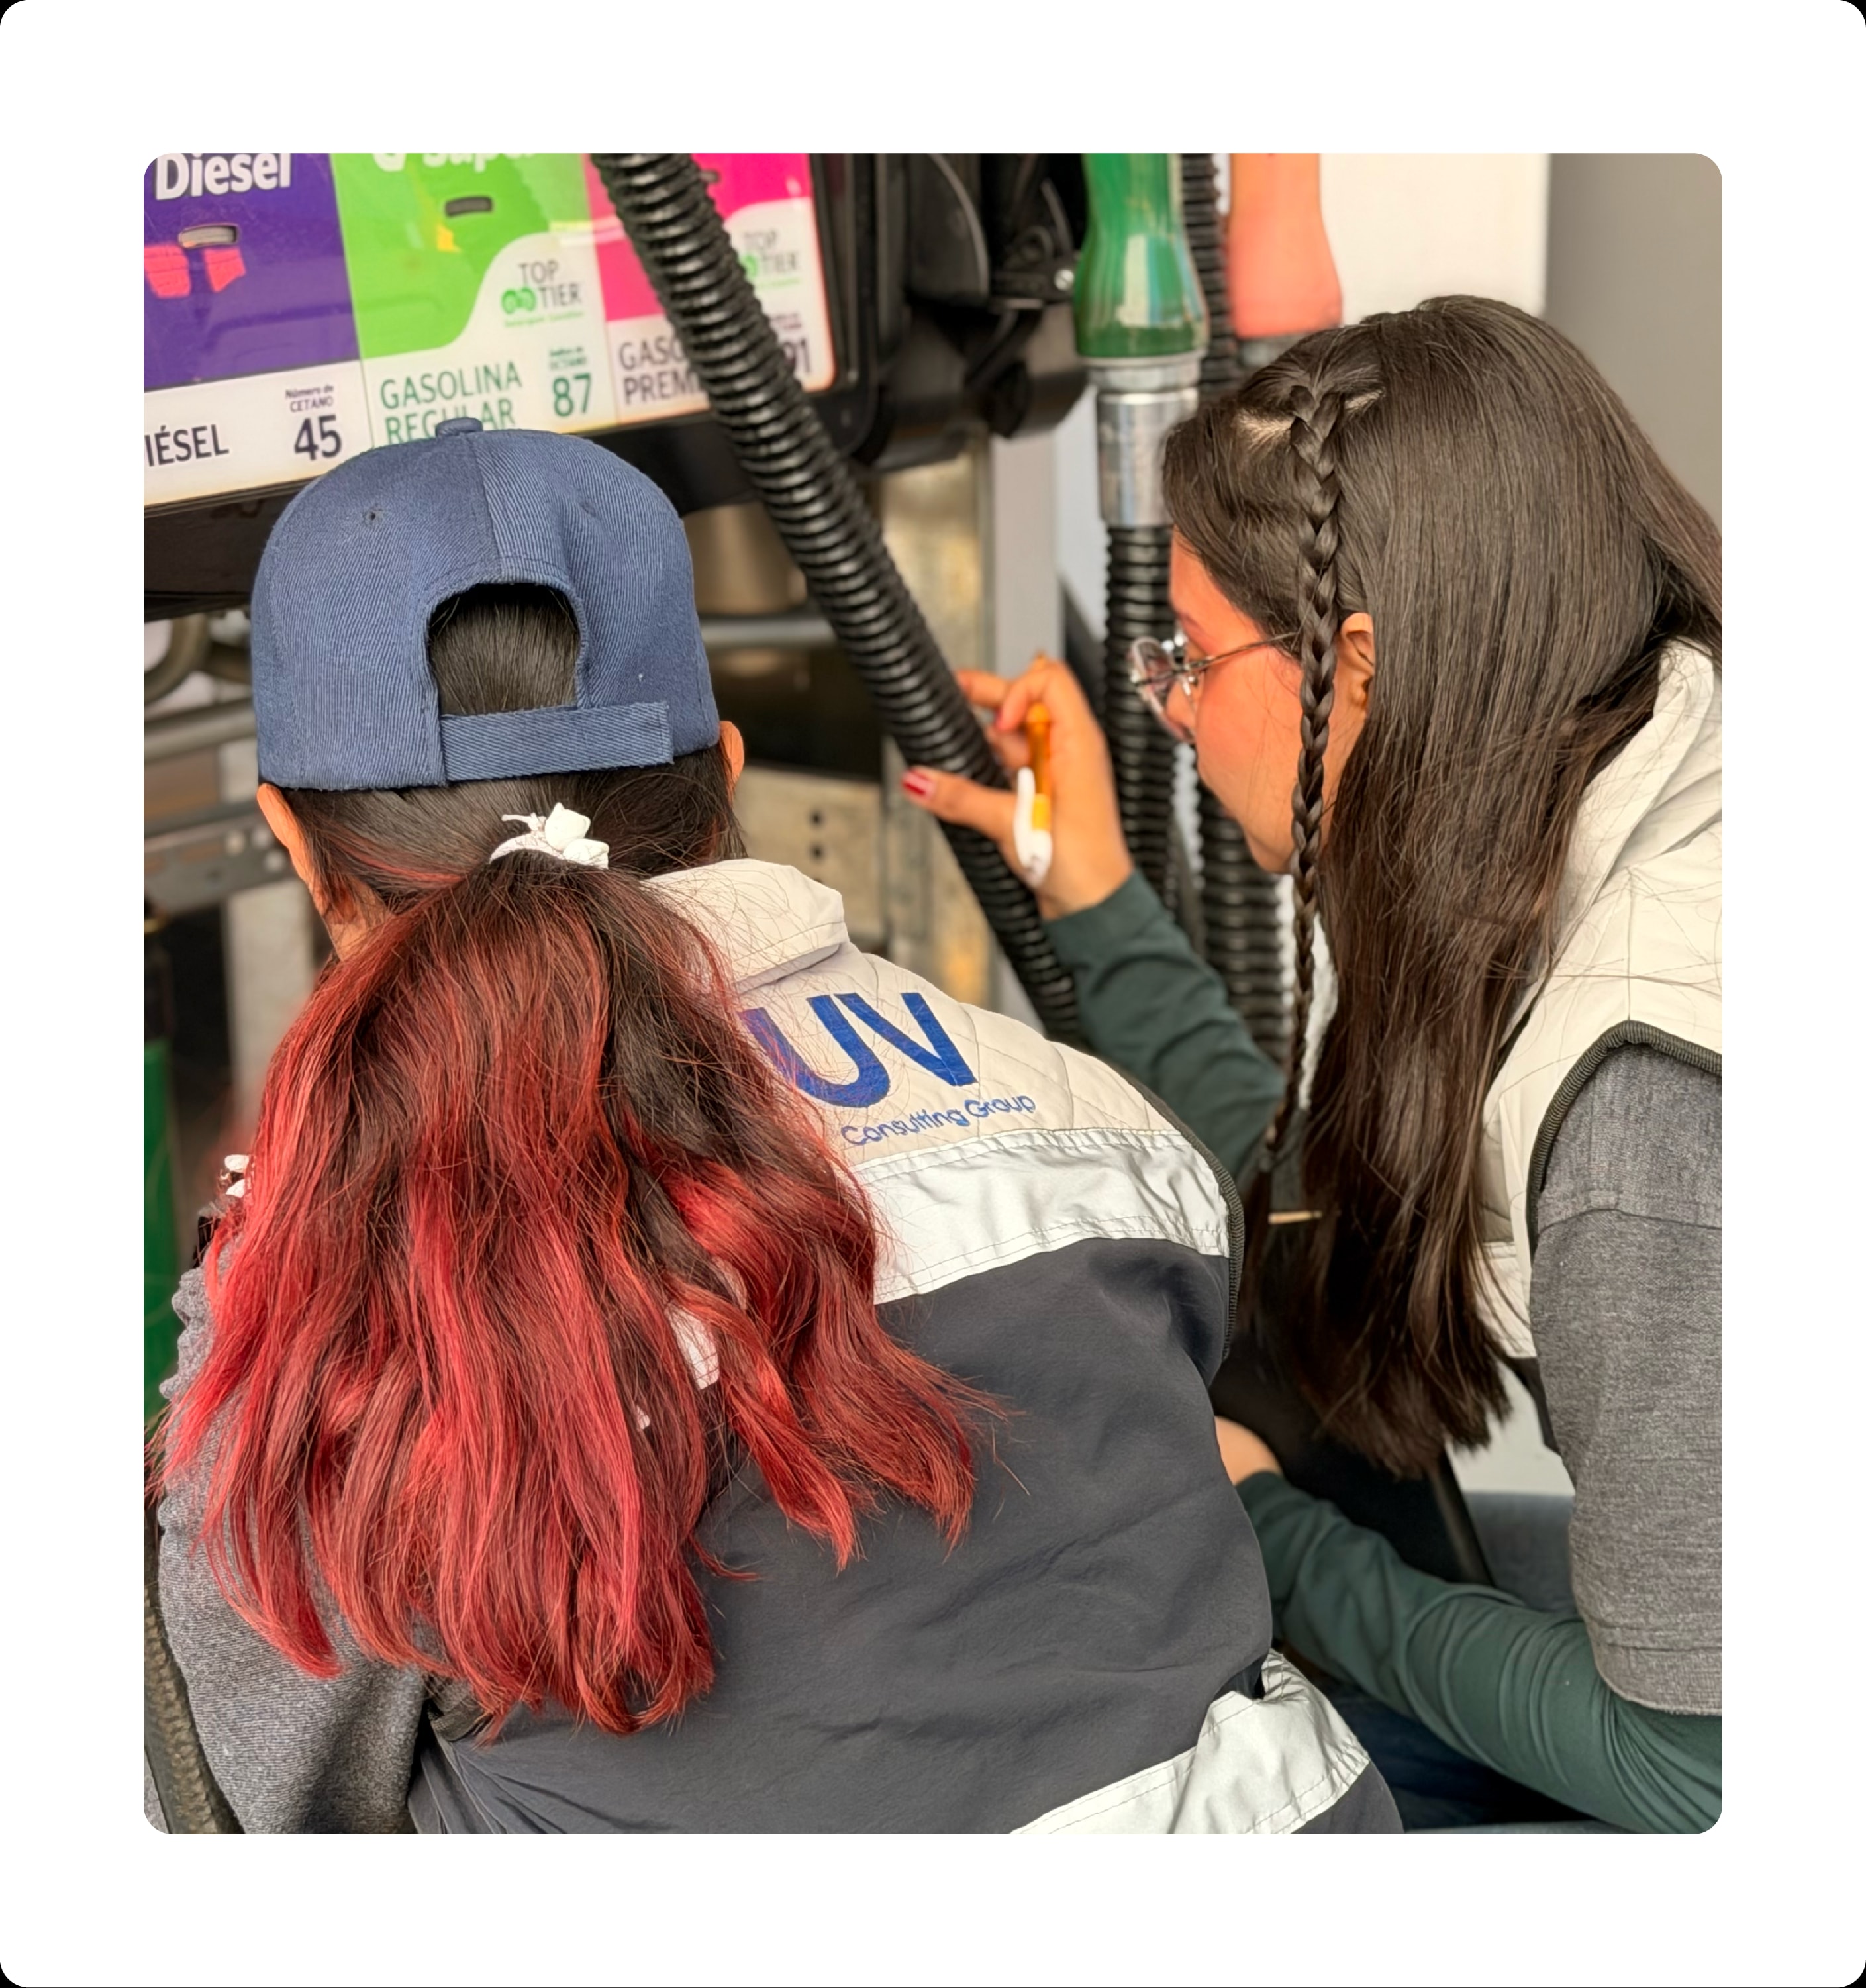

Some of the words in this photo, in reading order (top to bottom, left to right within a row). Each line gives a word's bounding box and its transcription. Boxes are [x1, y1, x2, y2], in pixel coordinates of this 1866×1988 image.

[156, 153, 291, 200] Diesel
[518, 258, 559, 286] TOP
[538, 281, 582, 309] TIER
[620, 336, 687, 371] GASO
[290, 396, 334, 412] CETANO
[381, 361, 522, 409] GASOLINA
[552, 372, 591, 417] 87
[624, 369, 697, 405] PREM
[294, 414, 342, 460] 45
[385, 398, 516, 444] REGAR
[144, 424, 230, 467] IÉSEL
[736, 992, 978, 1108] UV
[840, 1109, 970, 1146] Consulting
[964, 1095, 1036, 1118] Group
